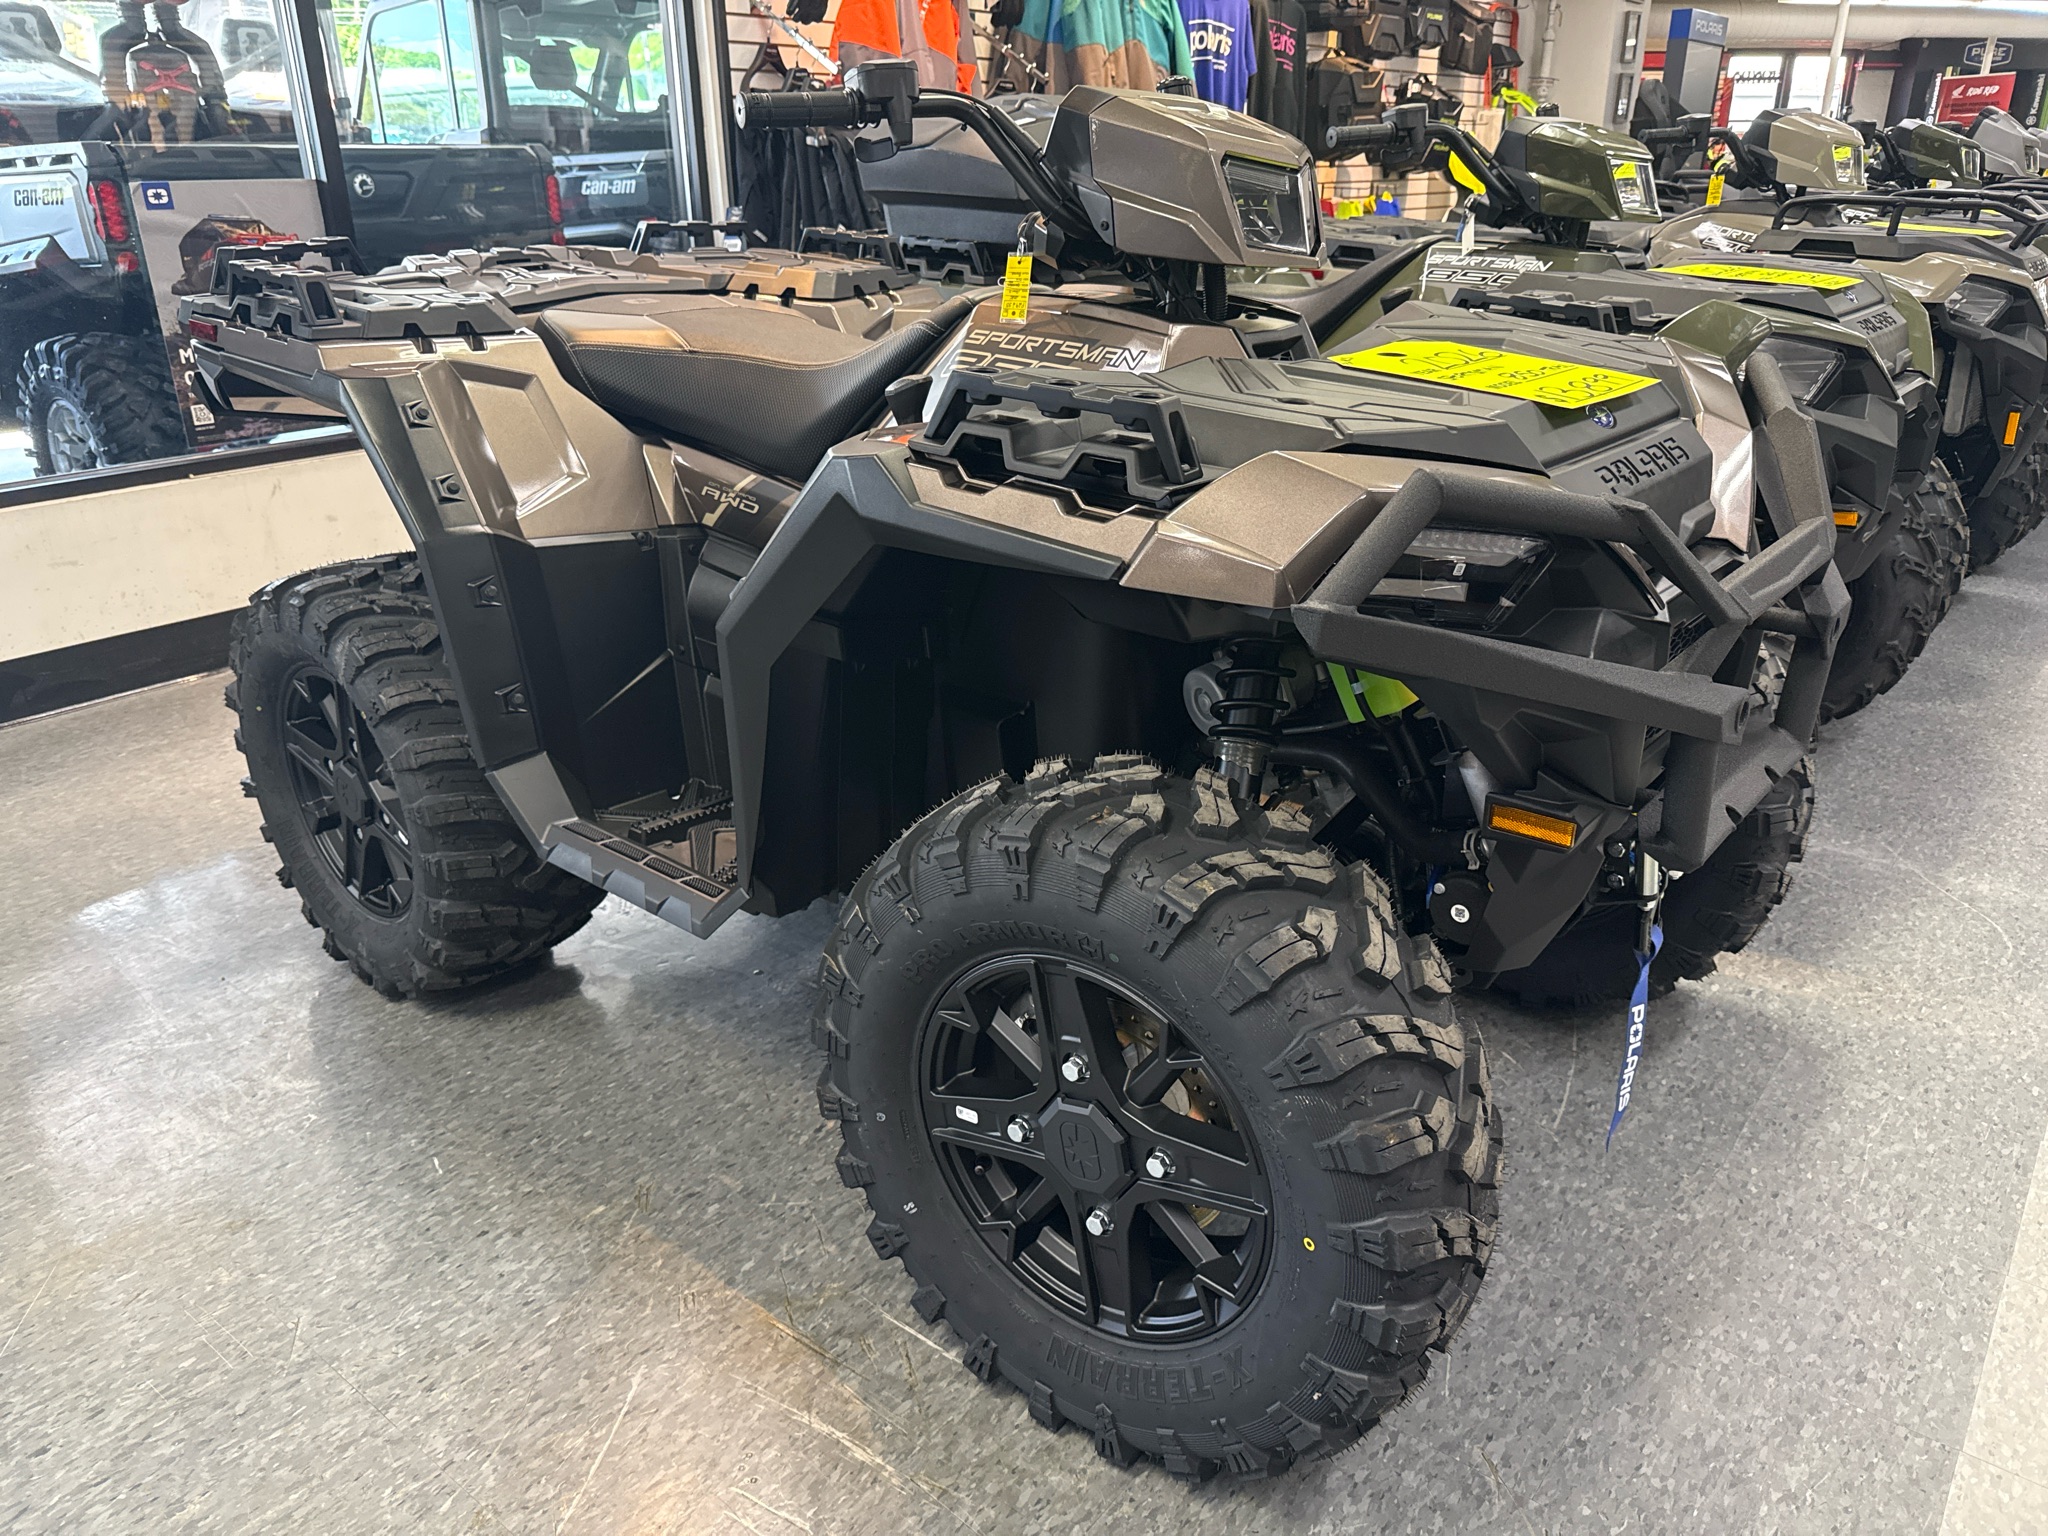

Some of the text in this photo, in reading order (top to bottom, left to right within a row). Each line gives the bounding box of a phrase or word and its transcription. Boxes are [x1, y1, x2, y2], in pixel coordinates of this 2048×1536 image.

[1695, 19, 1724, 36] POLARIS
[14, 187, 64, 207] can-am
[581, 179, 637, 195] can-am
[1427, 254, 1554, 272] SPORTSMAN
[965, 329, 1148, 370] SPORTSMAN
[1594, 437, 1690, 495] POLARIS
[701, 486, 760, 514] AWD
[1618, 1003, 1645, 1112] POLARIS
[1046, 1332, 1254, 1404] X-TERRAIN
